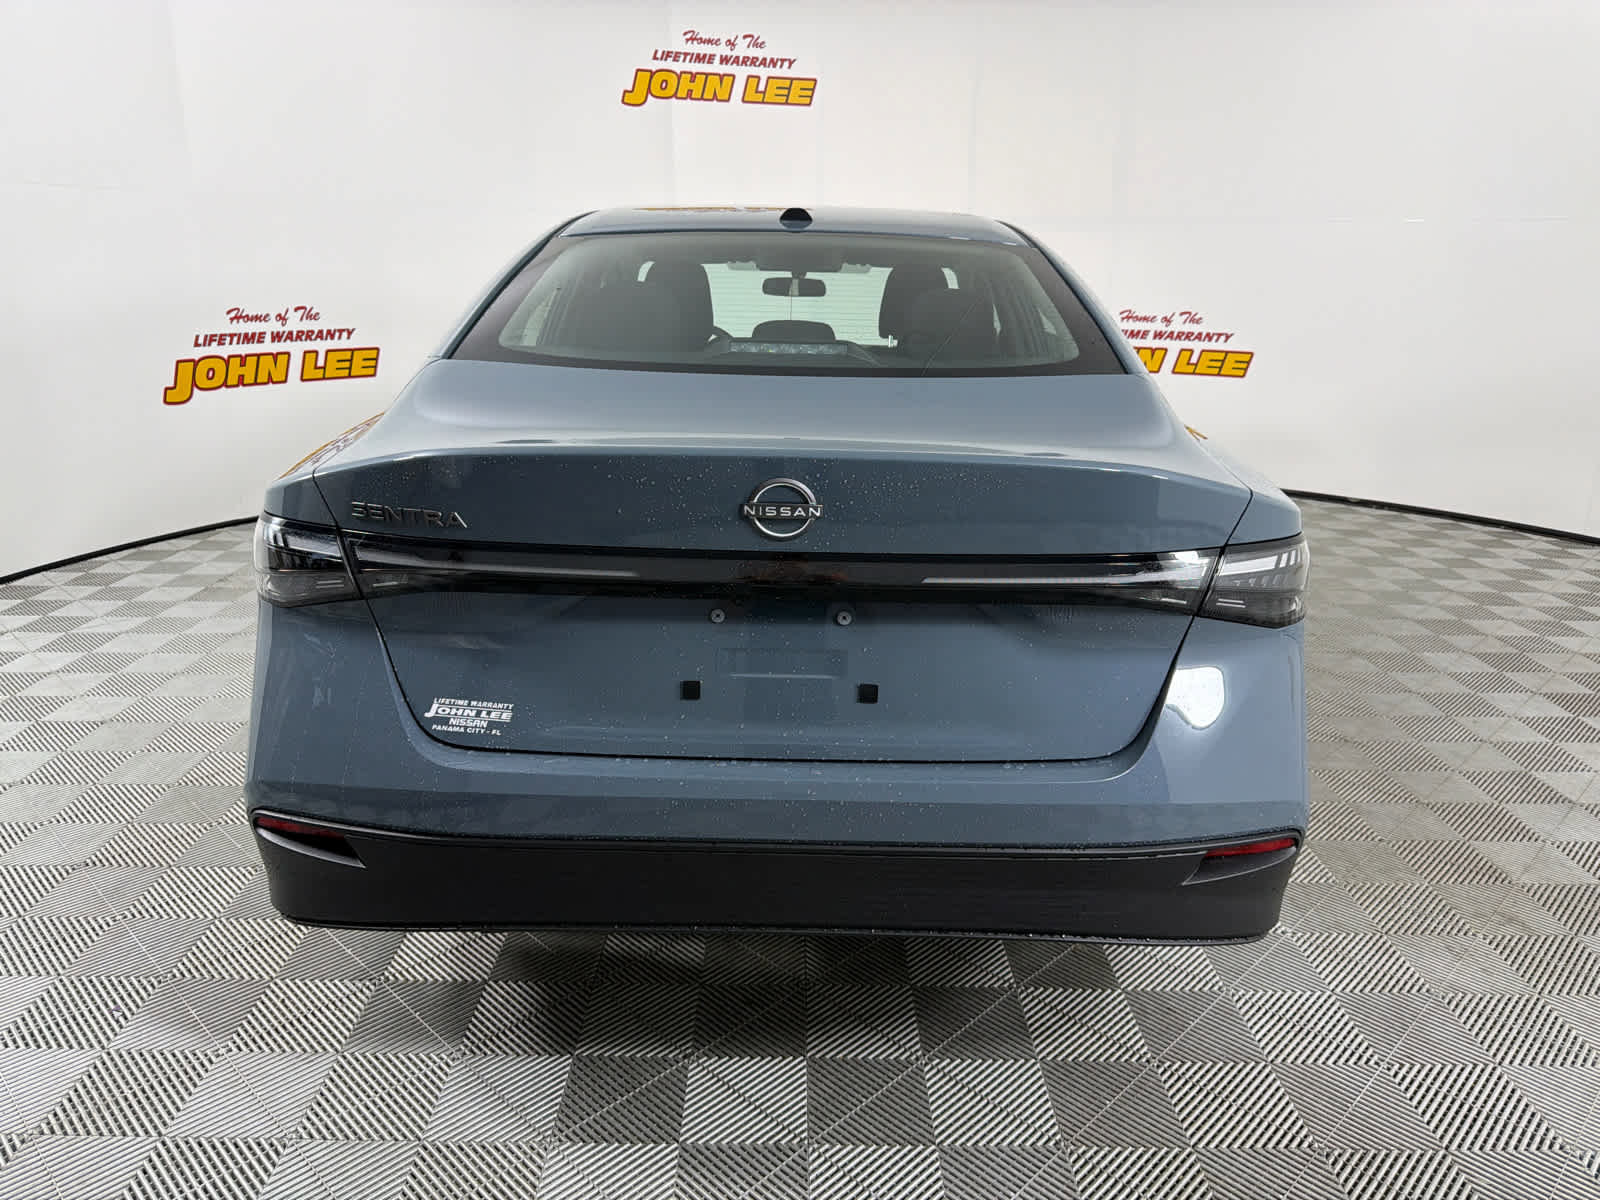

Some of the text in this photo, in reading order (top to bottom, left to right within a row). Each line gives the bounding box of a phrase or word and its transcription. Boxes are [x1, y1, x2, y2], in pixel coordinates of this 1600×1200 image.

[683, 30, 767, 51] Home of The
[652, 49, 796, 69] LIFETIME WARRANTY
[621, 68, 818, 107] JOHN LEE
[225, 305, 320, 326] Home of The
[1119, 309, 1203, 327] Home of The
[193, 328, 356, 347] LIFETIME WARRANTY
[1153, 330, 1234, 343] WARRANTY
[1172, 348, 1254, 378] LEE
[163, 347, 380, 405] JOHN LEE
[351, 500, 468, 529] SENTRA
[743, 505, 821, 517] NISSAN
[424, 703, 513, 720] JOHN LEE
[433, 697, 514, 709] LIFETIME WARRANTY
[432, 724, 465, 732] PANAMA
[449, 718, 488, 728] NISSAN
